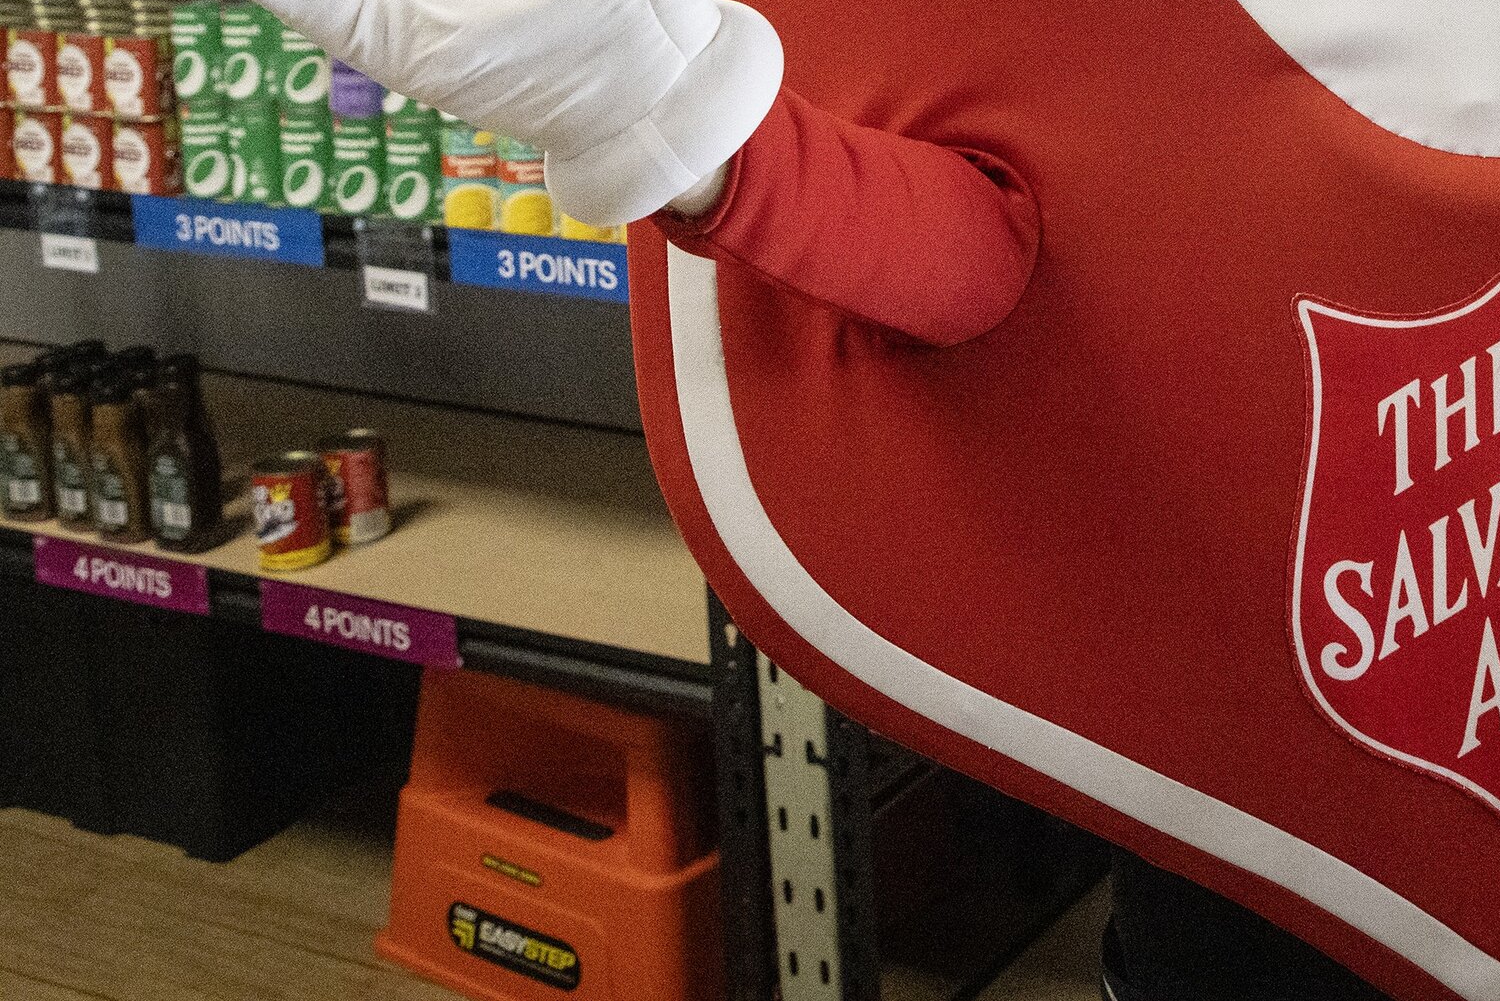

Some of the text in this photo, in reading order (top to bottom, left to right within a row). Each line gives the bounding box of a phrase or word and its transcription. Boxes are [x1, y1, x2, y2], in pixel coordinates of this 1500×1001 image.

[175, 213, 281, 251] 3 POINTS
[498, 249, 619, 291] 3 POINTS
[73, 556, 173, 600] 4 POINTS
[304, 604, 412, 651] 4 POINTS
